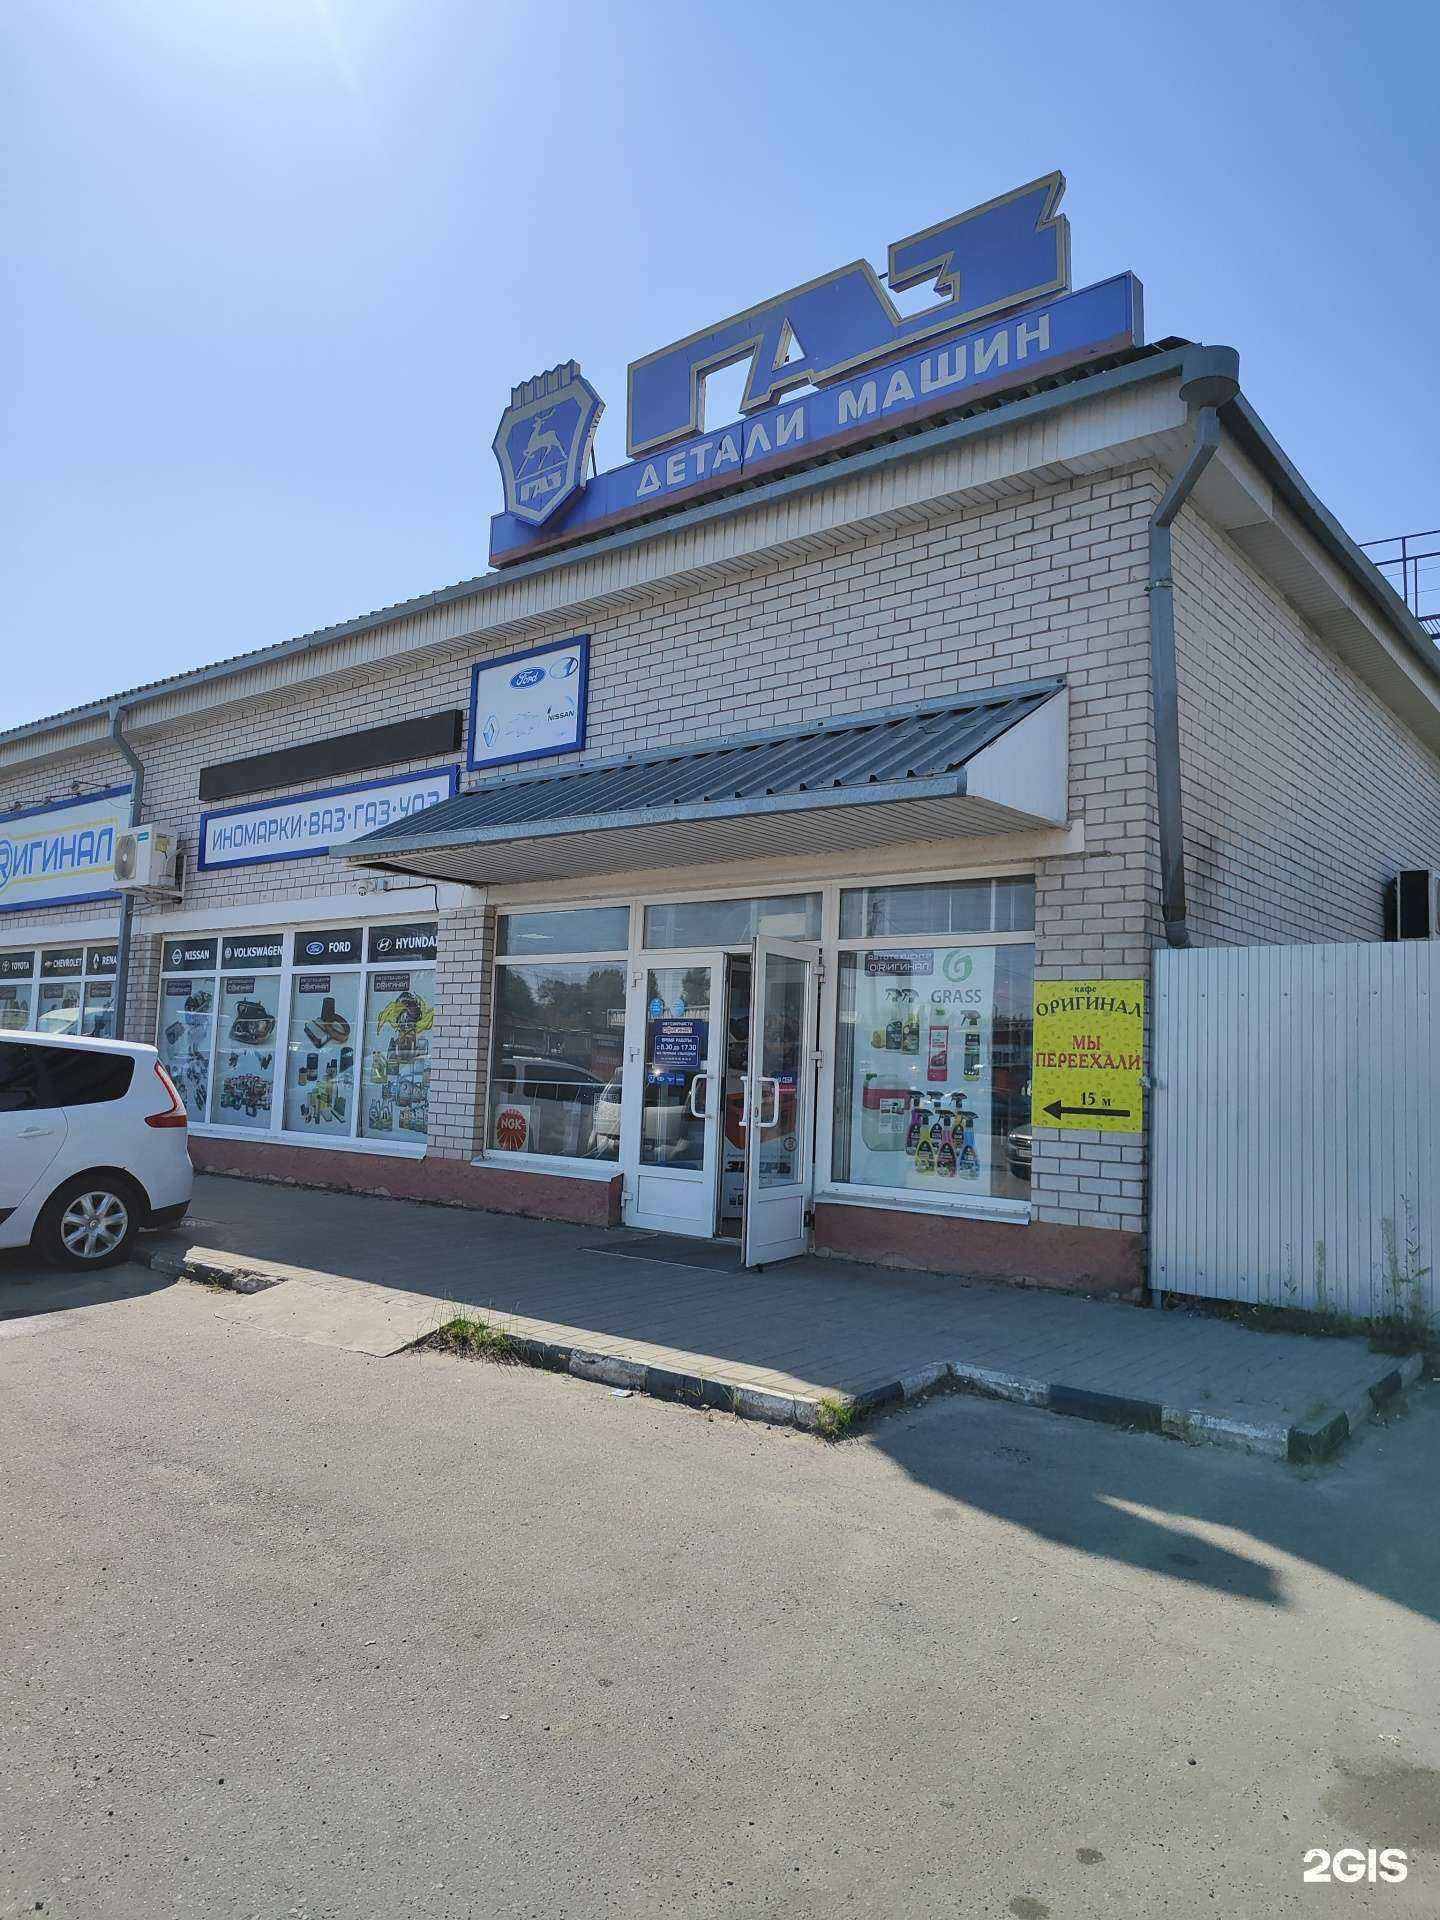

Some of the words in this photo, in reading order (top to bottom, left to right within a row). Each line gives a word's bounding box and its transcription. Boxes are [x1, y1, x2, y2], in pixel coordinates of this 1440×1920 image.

[628, 170, 1071, 459] ГАЗ
[636, 406, 805, 498] ДЕТАЛИ
[838, 313, 1050, 425] МАШИН
[520, 473, 562, 502] ГАЗ
[515, 670, 541, 686] Ford
[547, 710, 575, 722] NISSAN
[212, 813, 303, 851] ИНОМАРКИ
[308, 807, 346, 836] ВАЗ
[353, 800, 391, 828] ГАЗ
[233, 945, 284, 958] VOLKSWAGEN
[328, 941, 351, 953] FORD
[102, 955, 118, 965] RENA
[185, 949, 210, 960] NISSAN
[11, 961, 30, 970] TOYOTA
[53, 959, 82, 968] CHEVROLET
[931, 989, 983, 1003] GRASS
[1036, 996, 1142, 1018] ОРИГИНАЛ
[1072, 1035, 1104, 1051] МЫ
[1035, 1052, 1142, 1070] ПЕРЕЕХАЛИ
[1081, 1092, 1096, 1106] 15
[501, 1118, 522, 1130] NGK
